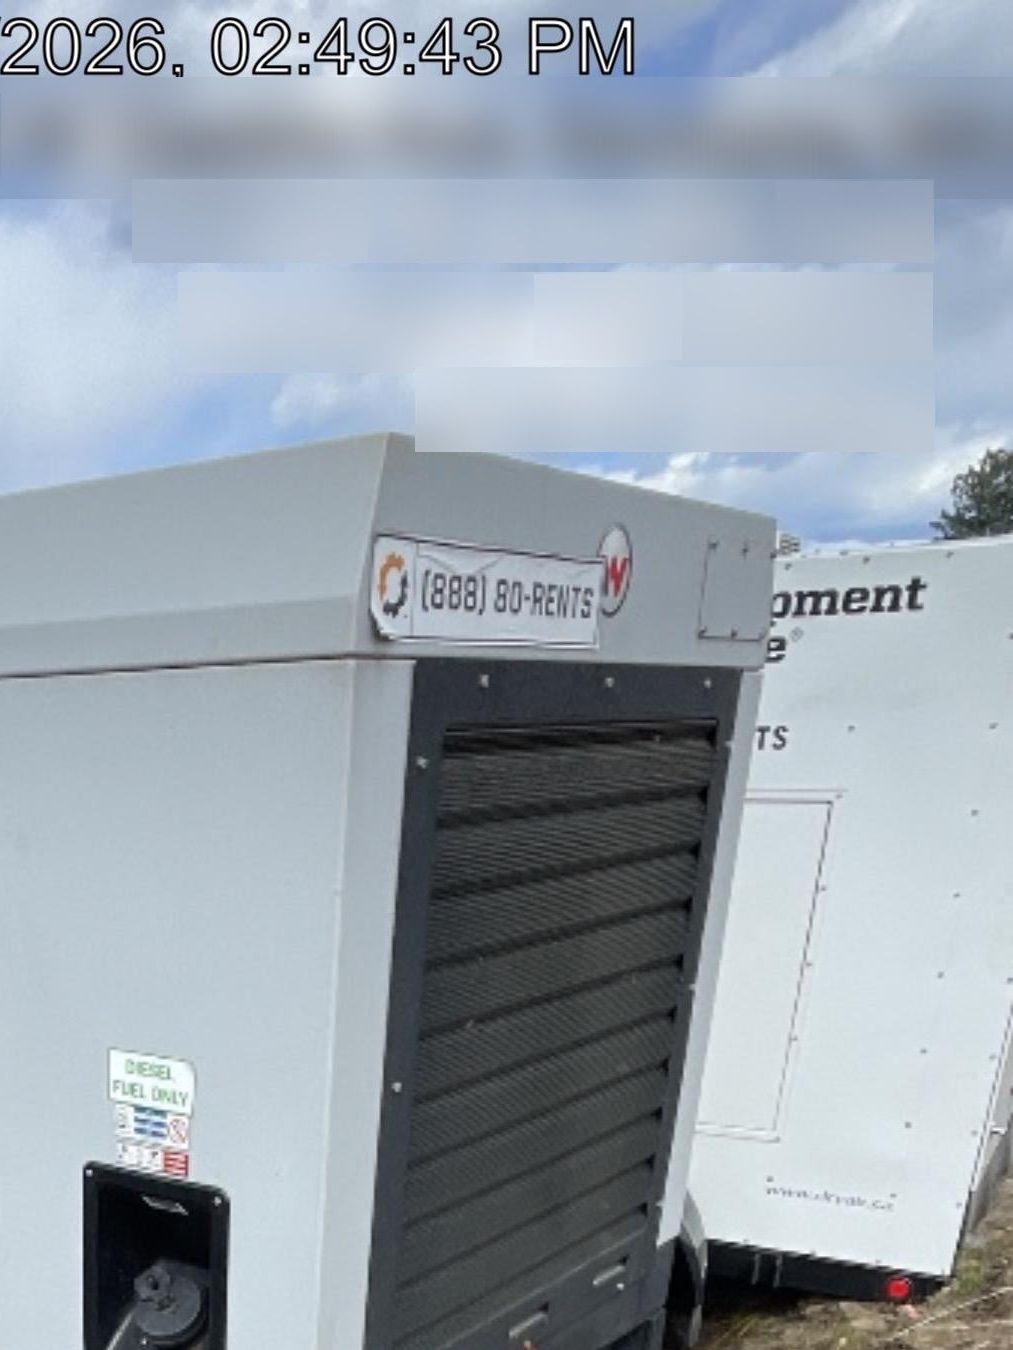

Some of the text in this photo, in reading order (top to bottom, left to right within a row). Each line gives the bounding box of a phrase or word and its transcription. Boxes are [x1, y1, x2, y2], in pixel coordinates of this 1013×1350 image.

[420, 569, 595, 619] (888) 80-RENTS
[123, 1058, 173, 1081] DIESEL
[112, 1079, 190, 1108] FUEL ONLY
